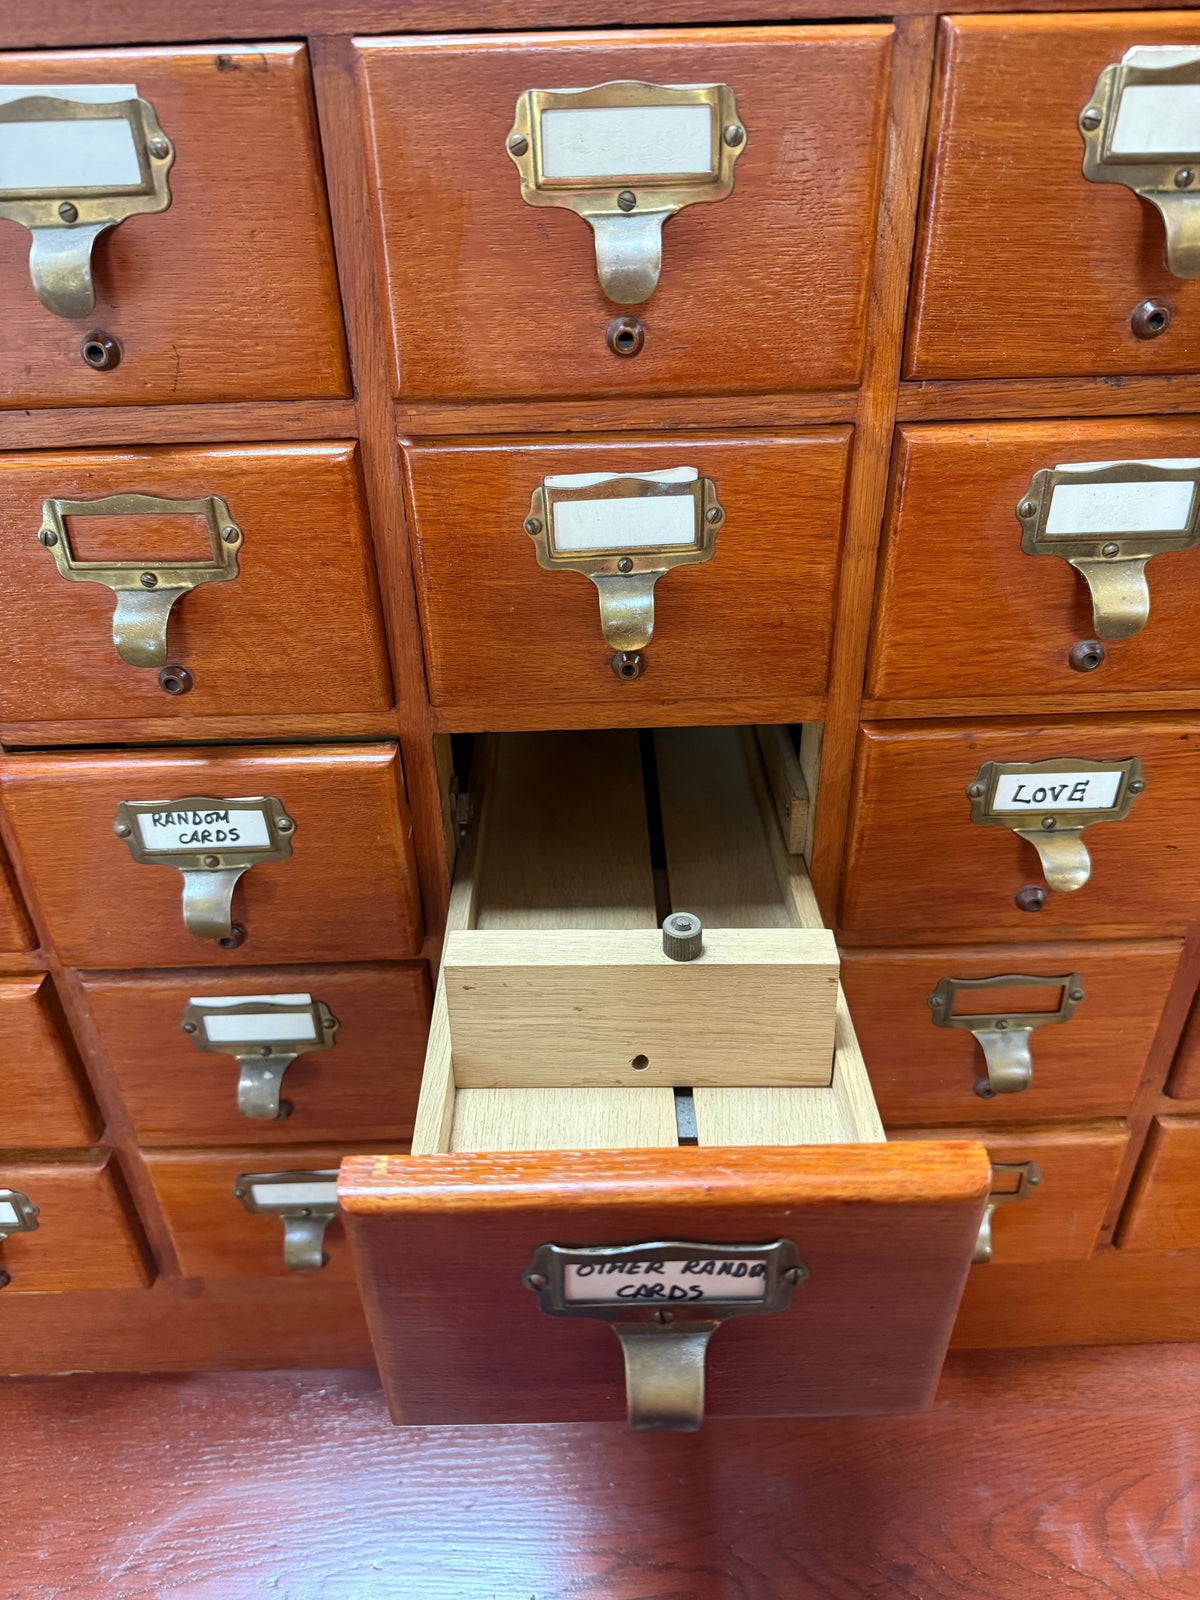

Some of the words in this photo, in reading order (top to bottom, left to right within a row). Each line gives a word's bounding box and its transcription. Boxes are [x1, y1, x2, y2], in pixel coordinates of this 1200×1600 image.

[1011, 780, 1090, 803] LOVE
[152, 811, 230, 827] RANDOM
[178, 828, 241, 844] CARDS
[576, 1261, 665, 1277] OTHER
[616, 1283, 704, 1300] CARDS
